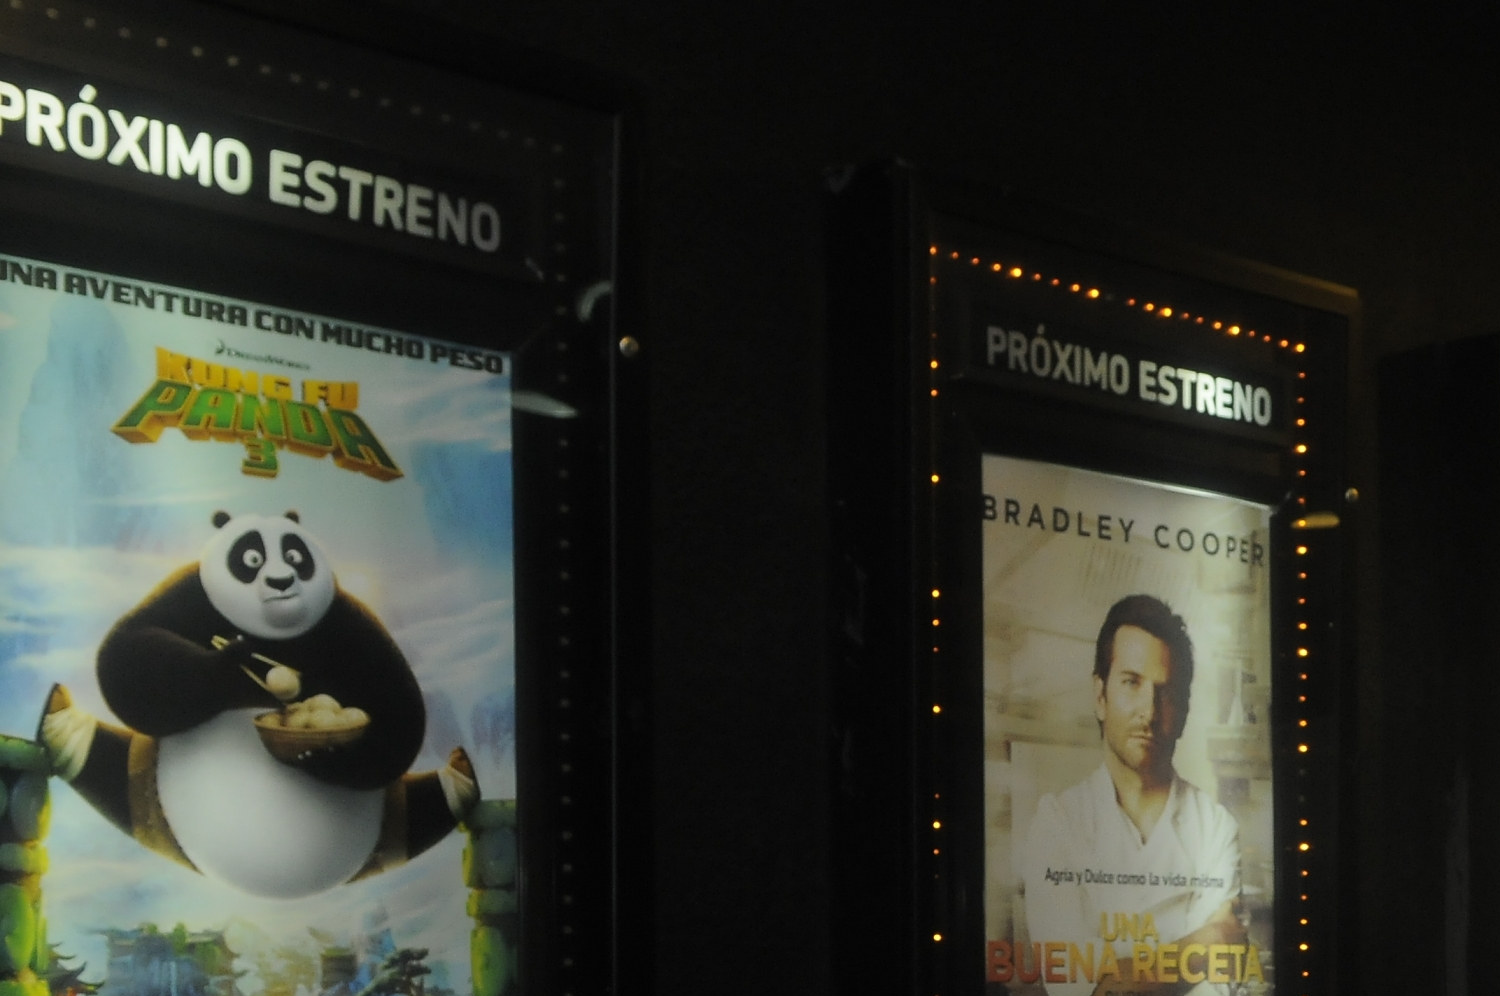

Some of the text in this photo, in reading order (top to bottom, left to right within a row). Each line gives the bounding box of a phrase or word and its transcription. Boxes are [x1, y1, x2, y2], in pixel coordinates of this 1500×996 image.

[0, 81, 501, 253] PRÓXIMO ESTRENO
[64, 272, 248, 327] AVENTURA
[253, 308, 314, 340] CON
[321, 320, 424, 360] MUCHO
[430, 343, 504, 375] PESO
[155, 346, 359, 411] KUNG FU
[986, 324, 1272, 427] PRÓXIMO ESTRENO
[110, 377, 405, 482] PANDA
[241, 437, 279, 478] 3
[982, 494, 1265, 568] BRADLEY COOPER
[1116, 873, 1146, 886] como
[1162, 873, 1187, 887] vida
[986, 940, 1265, 983] BUENA RECETA
[1101, 911, 1160, 943] UNA
